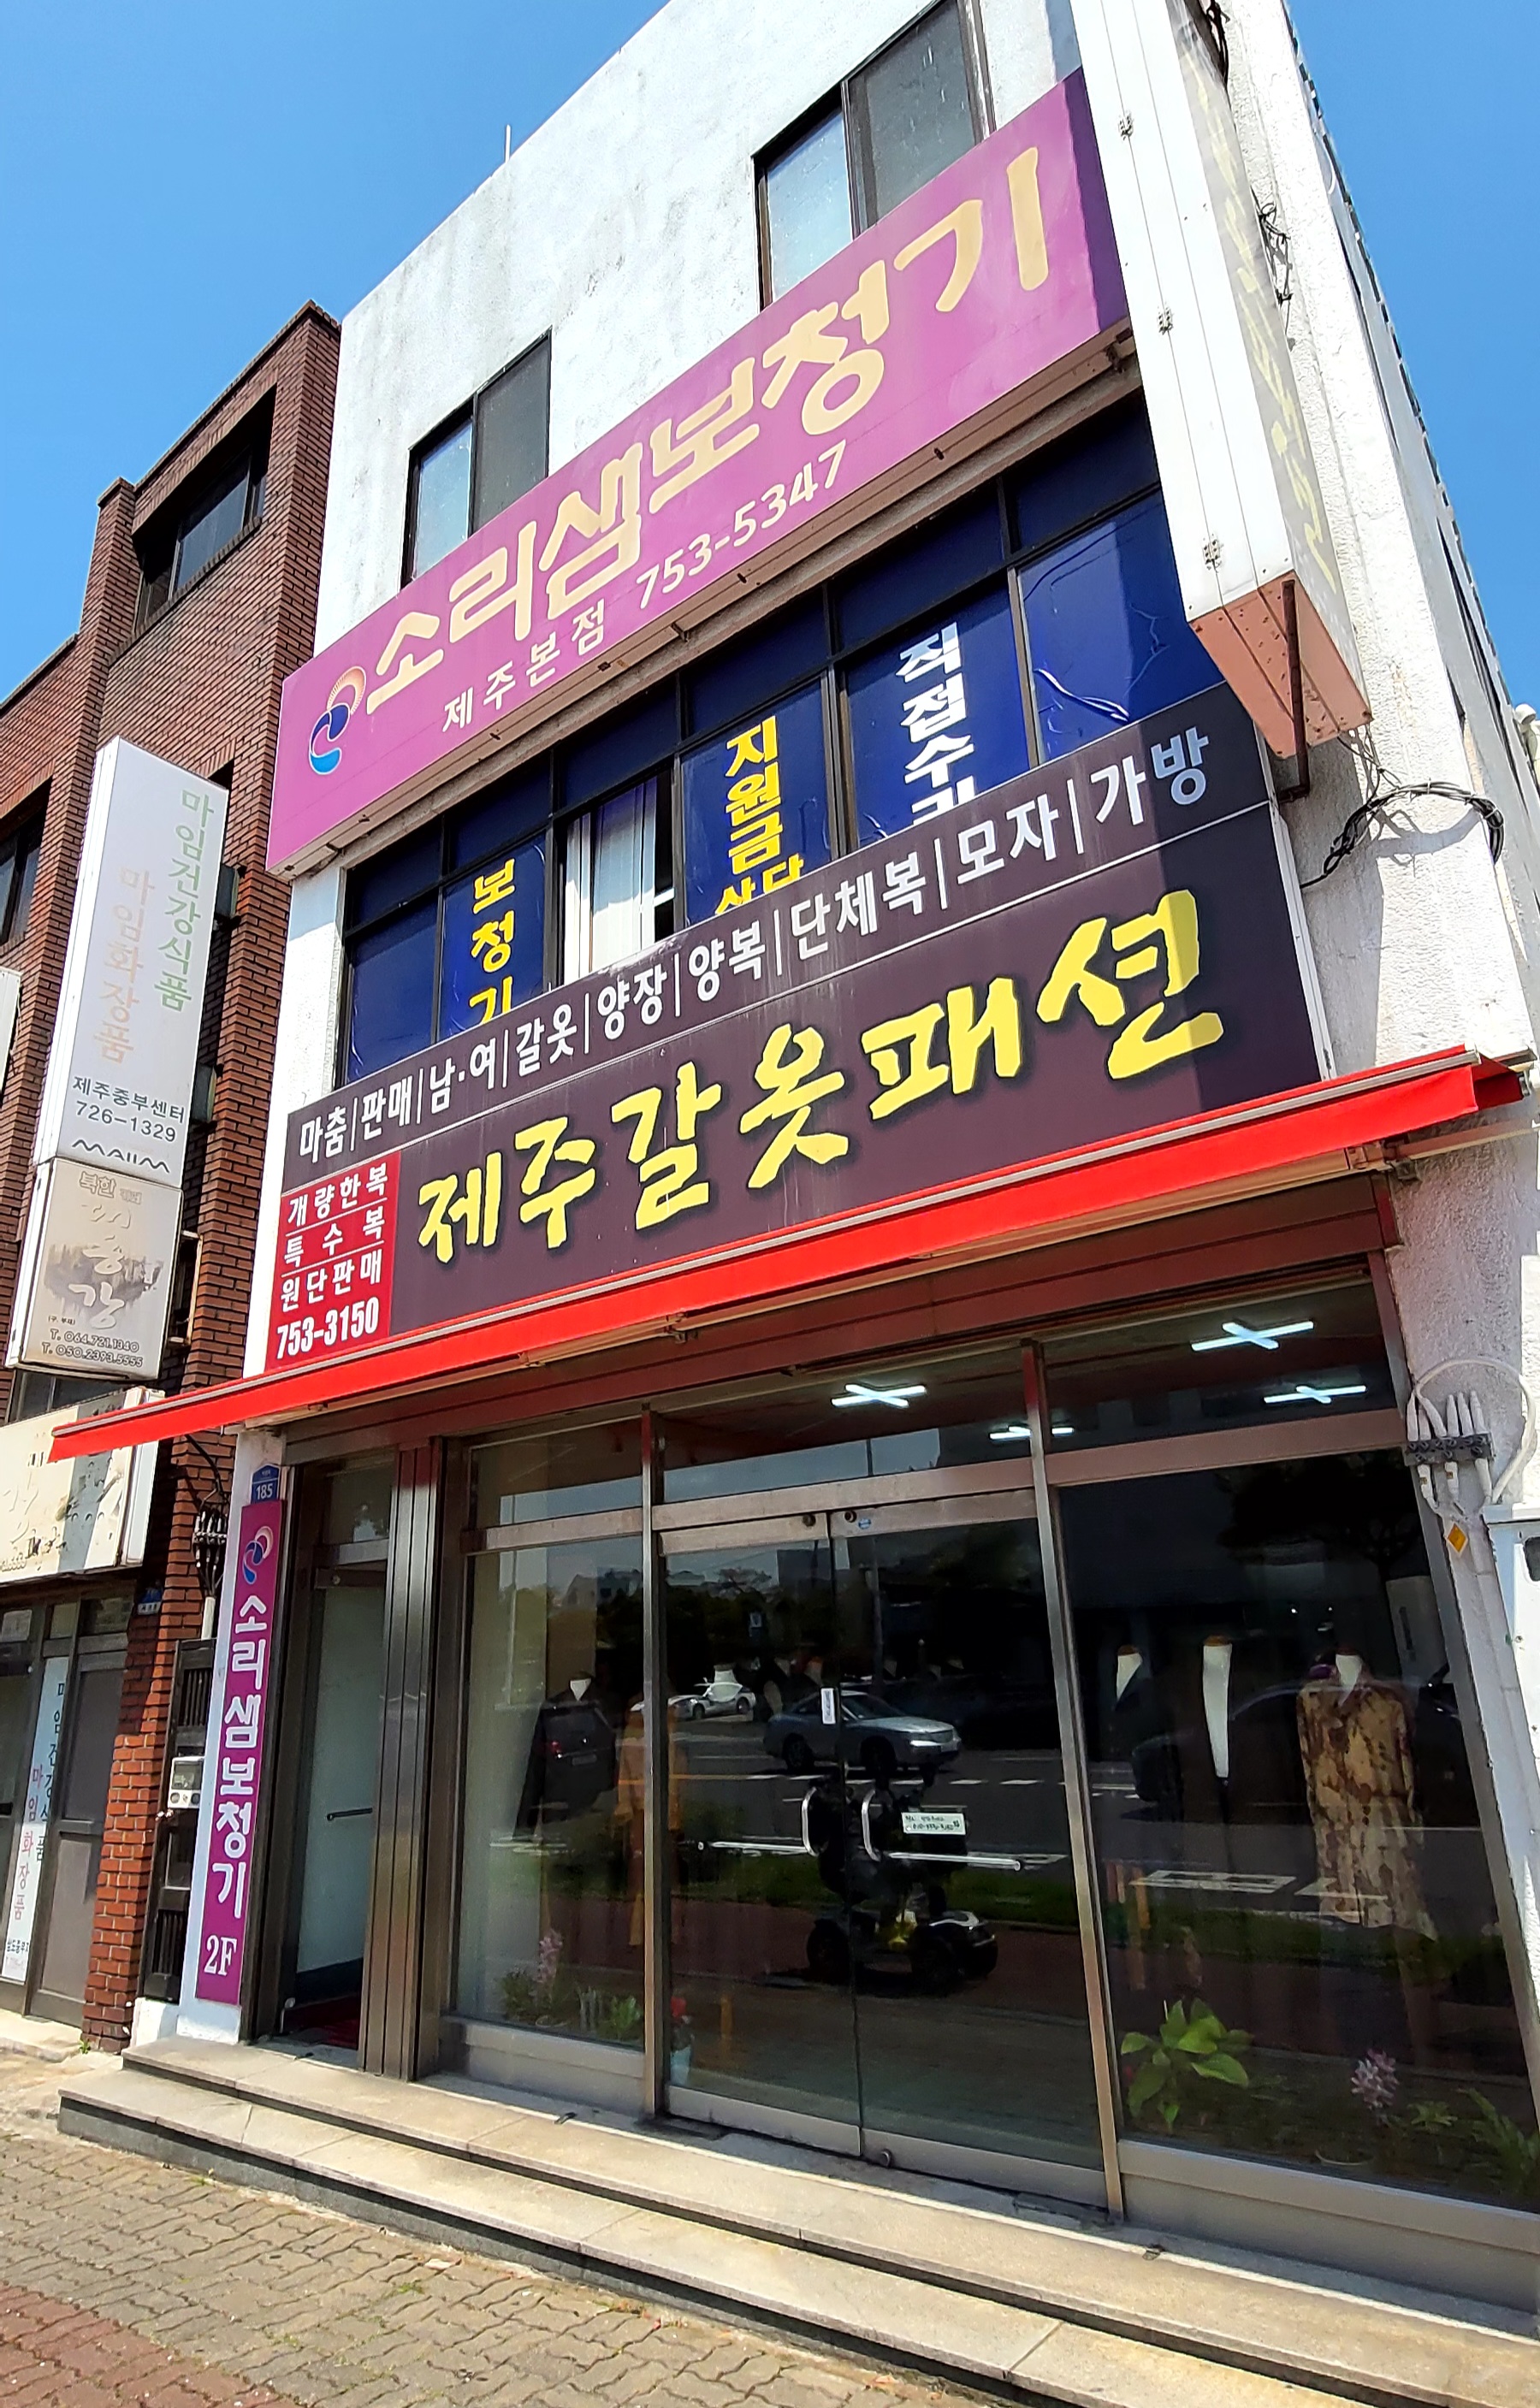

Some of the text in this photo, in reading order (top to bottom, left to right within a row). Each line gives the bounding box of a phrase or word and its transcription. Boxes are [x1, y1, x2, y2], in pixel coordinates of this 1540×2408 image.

[366, 147, 1049, 715] 소리샘보청기
[636, 440, 846, 610] 753-5347
[726, 715, 783, 875] 지원금
[94, 866, 156, 1065] 마임화장품
[154, 789, 214, 1013] 마임건강식품
[299, 1109, 346, 1164] 마춤
[361, 1074, 412, 1141] 판매
[515, 1003, 578, 1077] 갈옷
[597, 966, 668, 1038] 양장
[688, 920, 767, 1003] 양복
[791, 852, 927, 961] 단체복
[957, 793, 1059, 885] 모자
[1090, 727, 1210, 826] 가방
[470, 858, 515, 1025] 보청기
[72, 1076, 185, 1124] 제주중부센터
[76, 1100, 176, 1142] 726-1329
[287, 1163, 388, 1227] 개량한복
[275, 1297, 379, 1360] 753-3150
[280, 1251, 382, 1311] 원단판매
[256, 1483, 274, 1500] 185
[211, 1594, 268, 1920] 소리샘보청기
[205, 1935, 238, 1976] 2F
